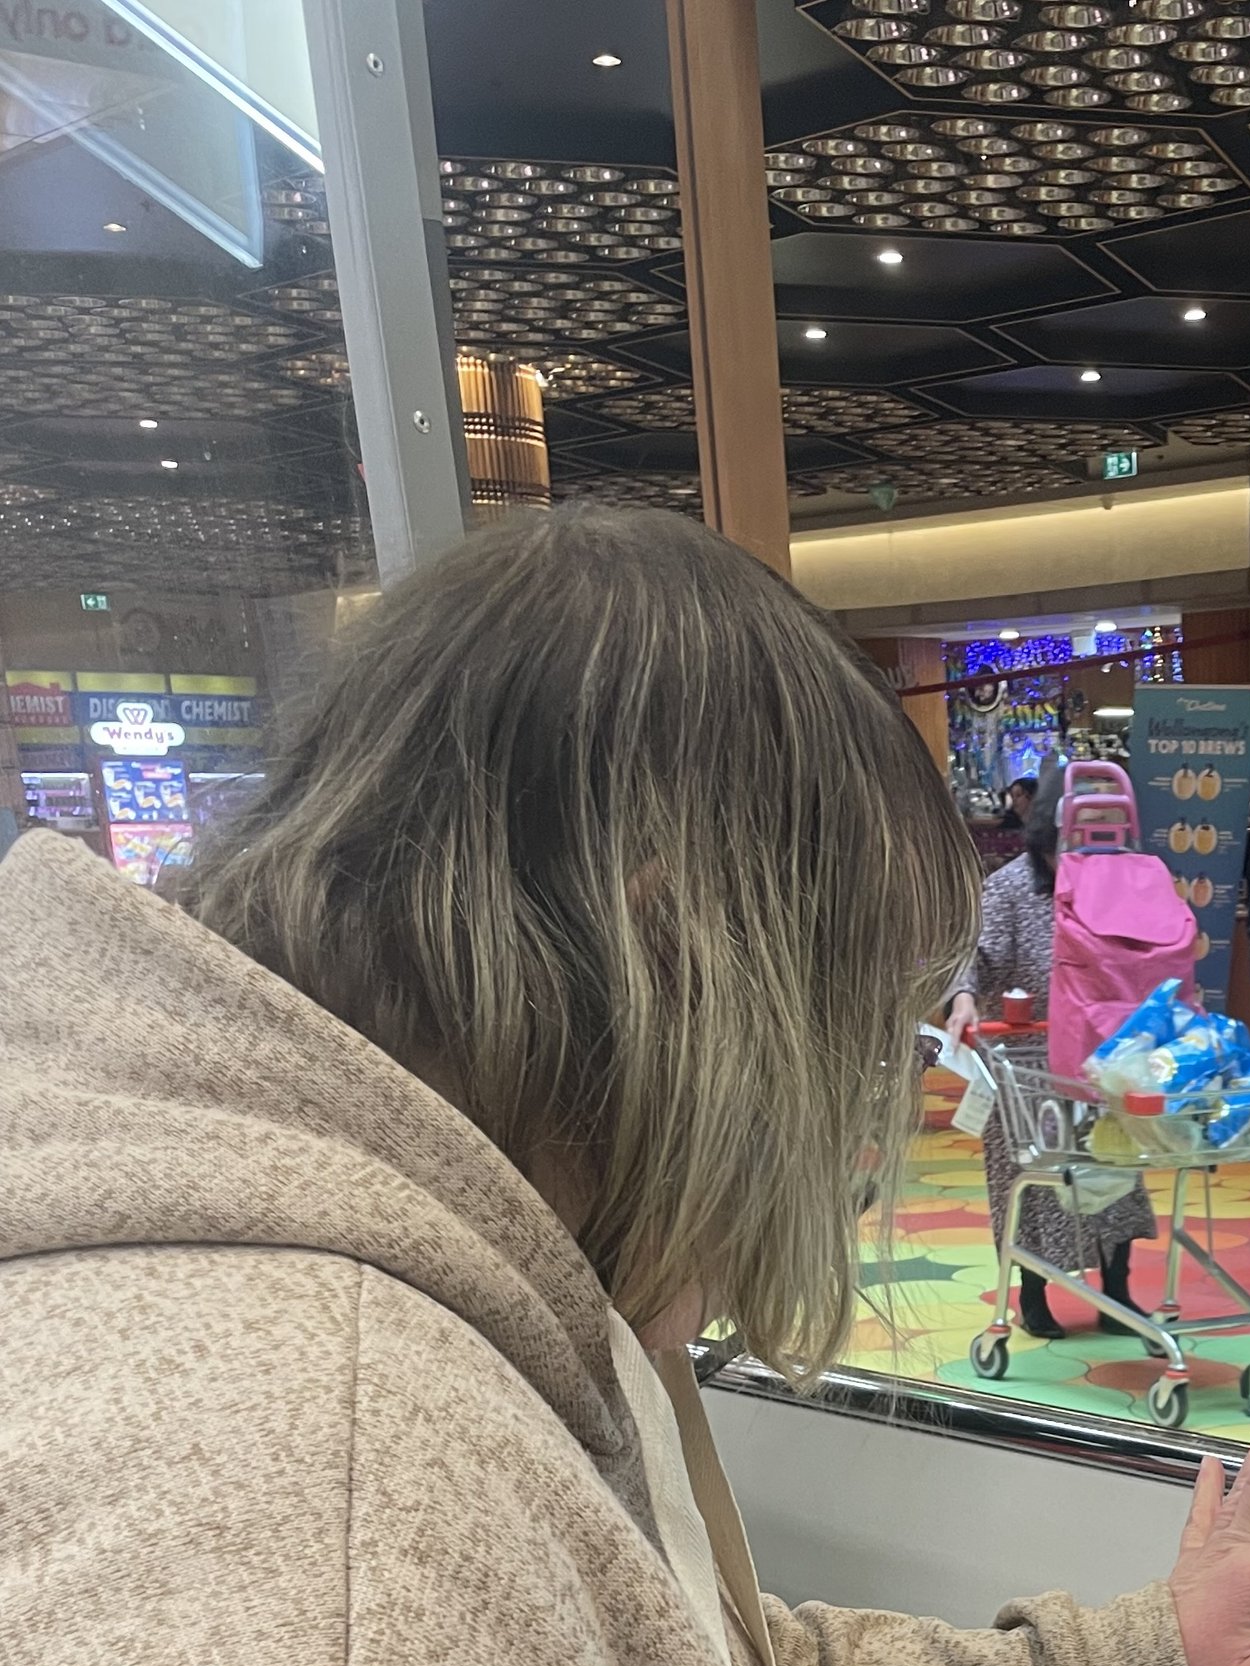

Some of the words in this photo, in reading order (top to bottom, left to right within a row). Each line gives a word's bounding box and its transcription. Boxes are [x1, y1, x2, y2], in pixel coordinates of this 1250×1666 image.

[181, 700, 250, 722] CHEMIST
[103, 727, 174, 743] Wendy's
[1148, 740, 1179, 754] TOP
[1181, 740, 1196, 754] 10
[1198, 740, 1246, 755] BREWS
